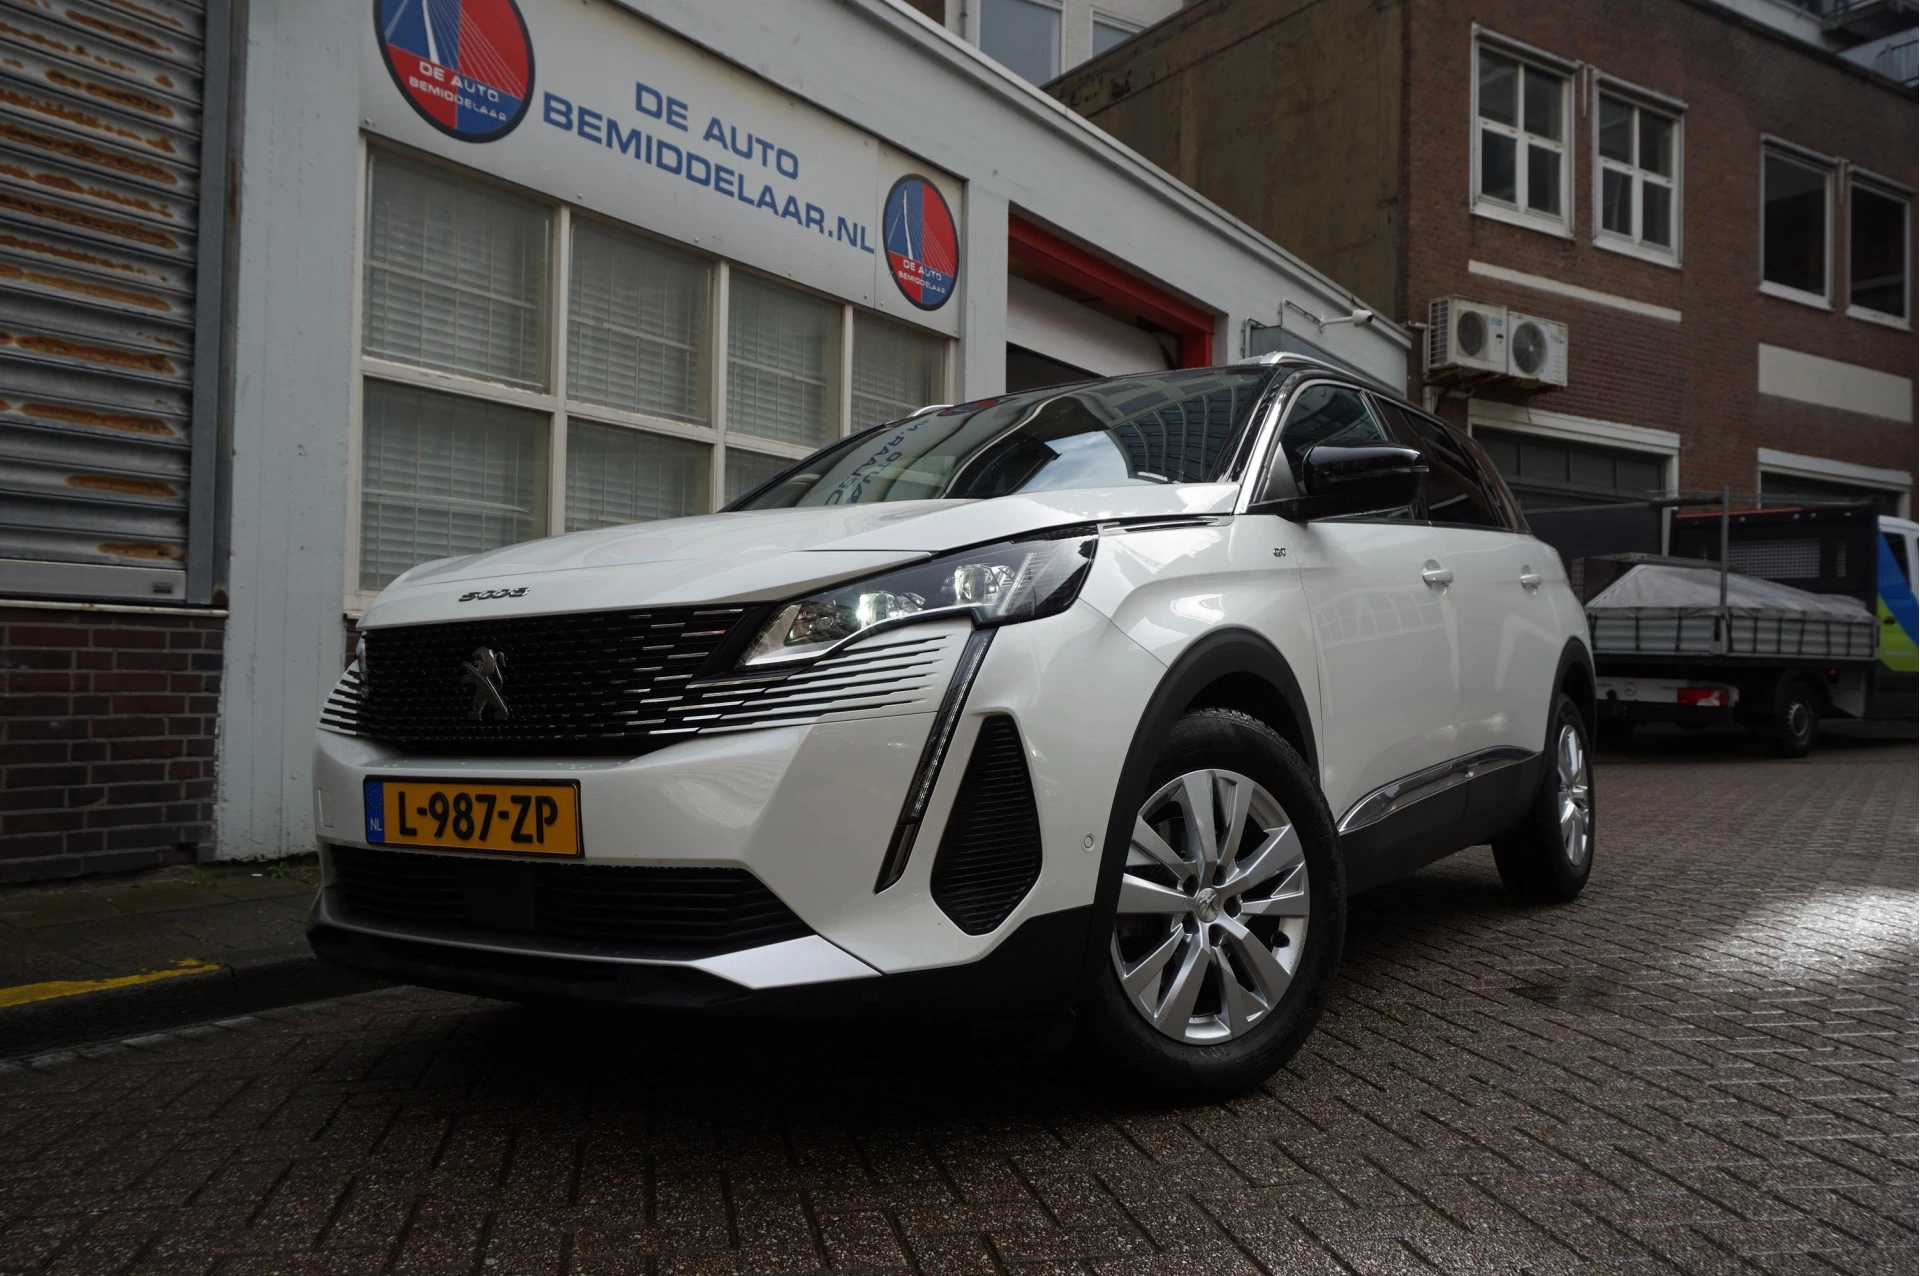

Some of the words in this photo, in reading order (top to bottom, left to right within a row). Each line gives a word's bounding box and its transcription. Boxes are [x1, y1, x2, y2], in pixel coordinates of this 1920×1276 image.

[408, 76, 507, 121] BEMIDDELAAR
[419, 60, 445, 82] DE
[450, 75, 499, 102] AUTO
[635, 81, 688, 132] DE
[703, 117, 799, 180] AUTO
[543, 91, 875, 254] BEMIDDELAAR.NL
[897, 270, 946, 294] BEMIDDELAAR
[903, 259, 916, 272] DE
[918, 265, 942, 281] AUTO
[370, 817, 383, 831] NL
[398, 791, 559, 844] L-987-ZP
